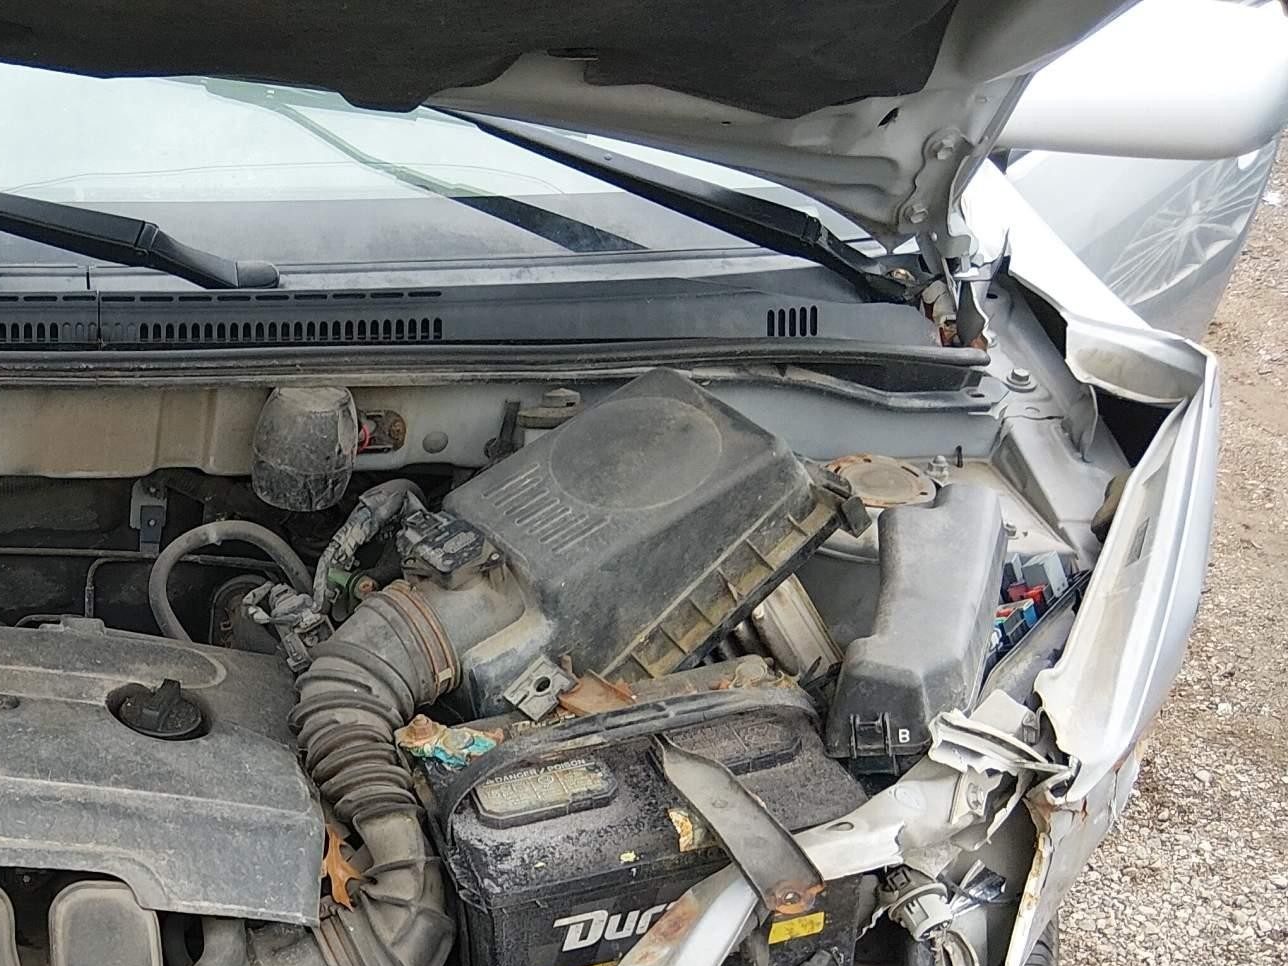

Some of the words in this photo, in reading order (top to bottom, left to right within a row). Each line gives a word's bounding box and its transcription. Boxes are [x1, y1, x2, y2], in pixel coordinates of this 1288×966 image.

[898, 727, 910, 744] B
[494, 768, 537, 783] DANGER
[547, 759, 586, 772] POISON
